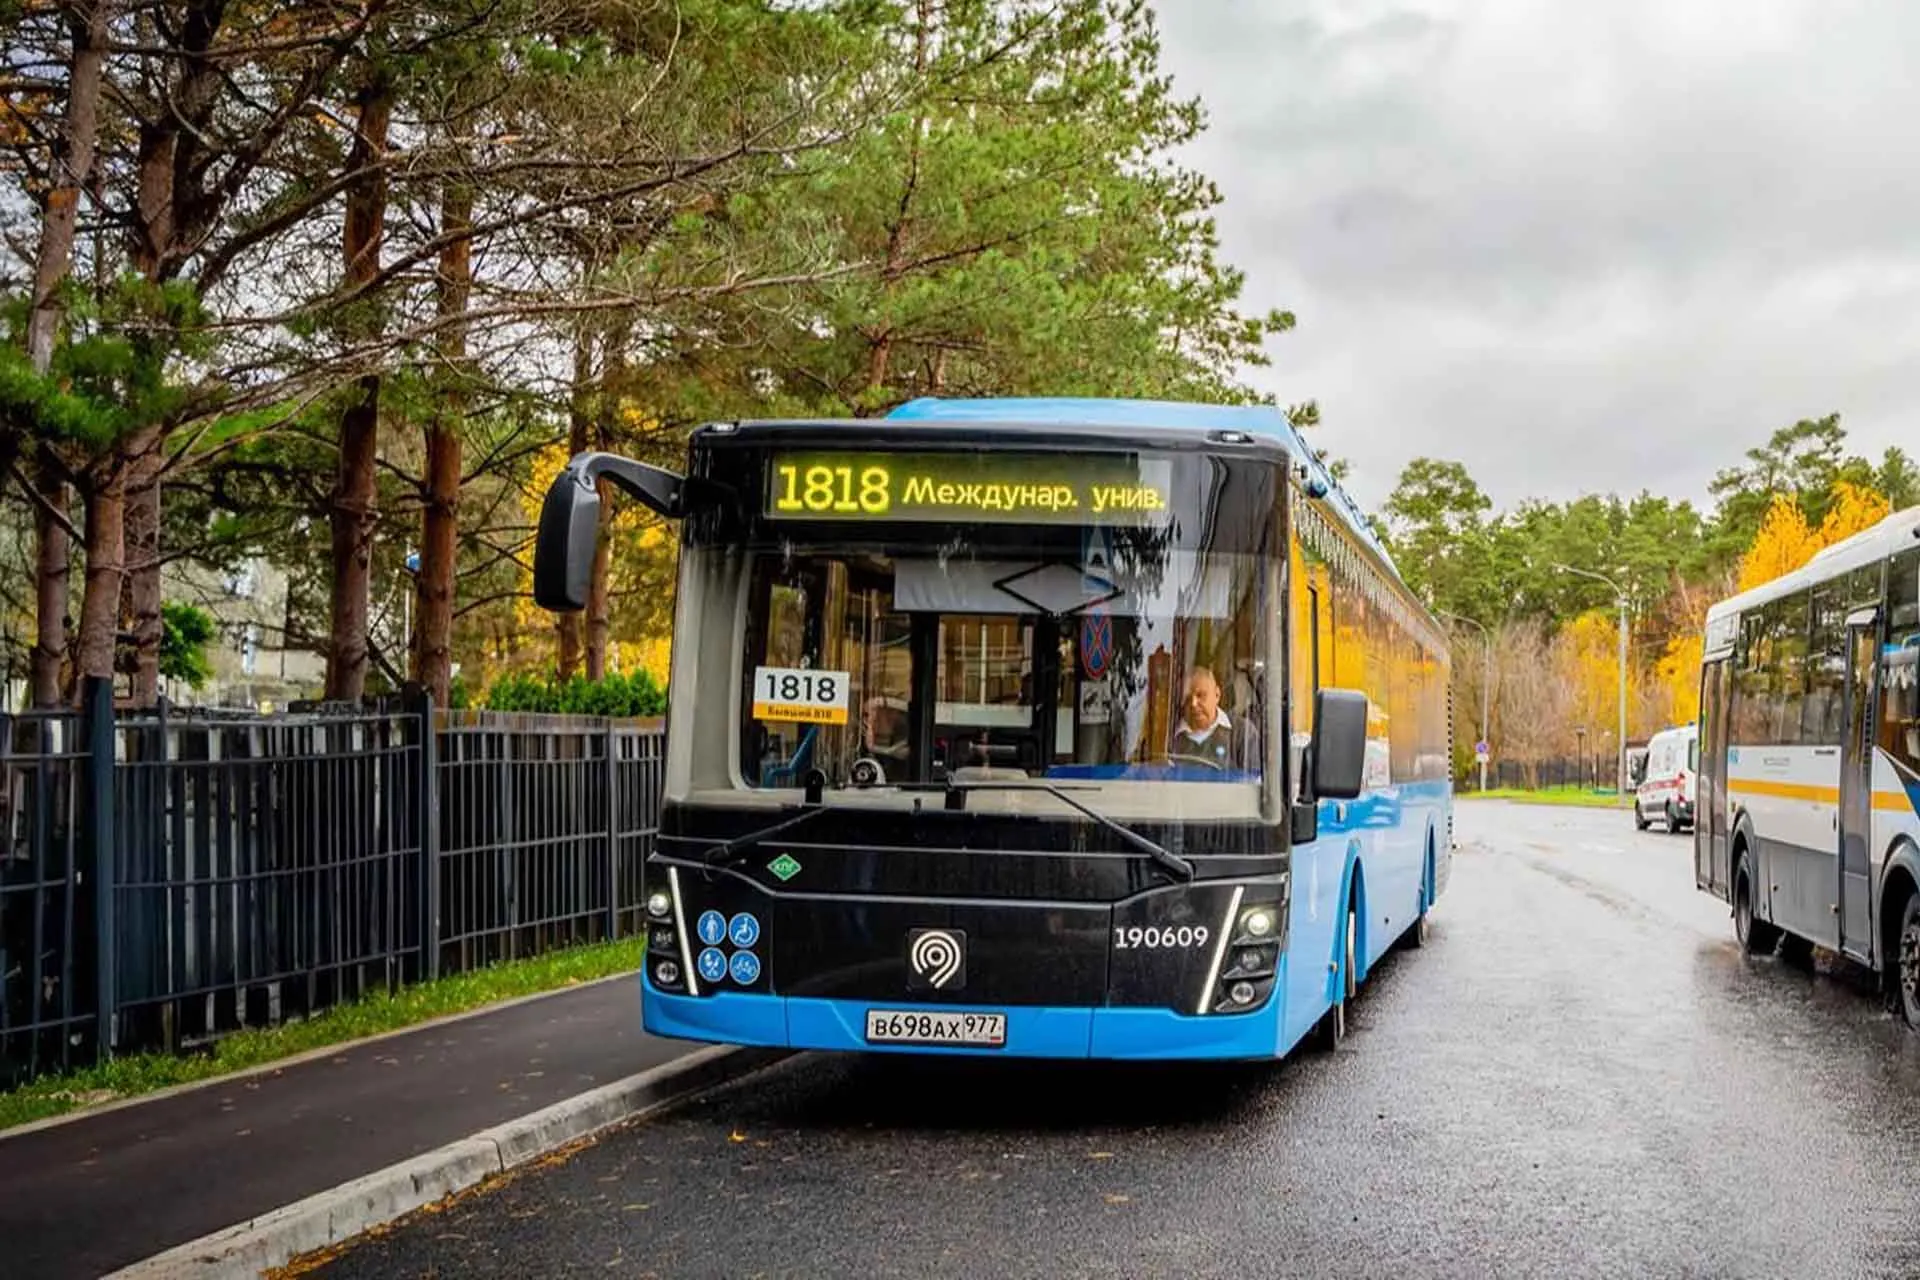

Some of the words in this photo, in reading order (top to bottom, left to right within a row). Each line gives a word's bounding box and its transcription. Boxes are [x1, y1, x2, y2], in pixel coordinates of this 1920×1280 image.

[777, 465, 889, 512] 1818
[903, 476, 1080, 511] Междунар.
[1092, 486, 1167, 513] унив.
[766, 674, 835, 702] 1818
[1114, 926, 1209, 948] 190609
[875, 1014, 960, 1039] В698АХ
[965, 1016, 998, 1033] 977
